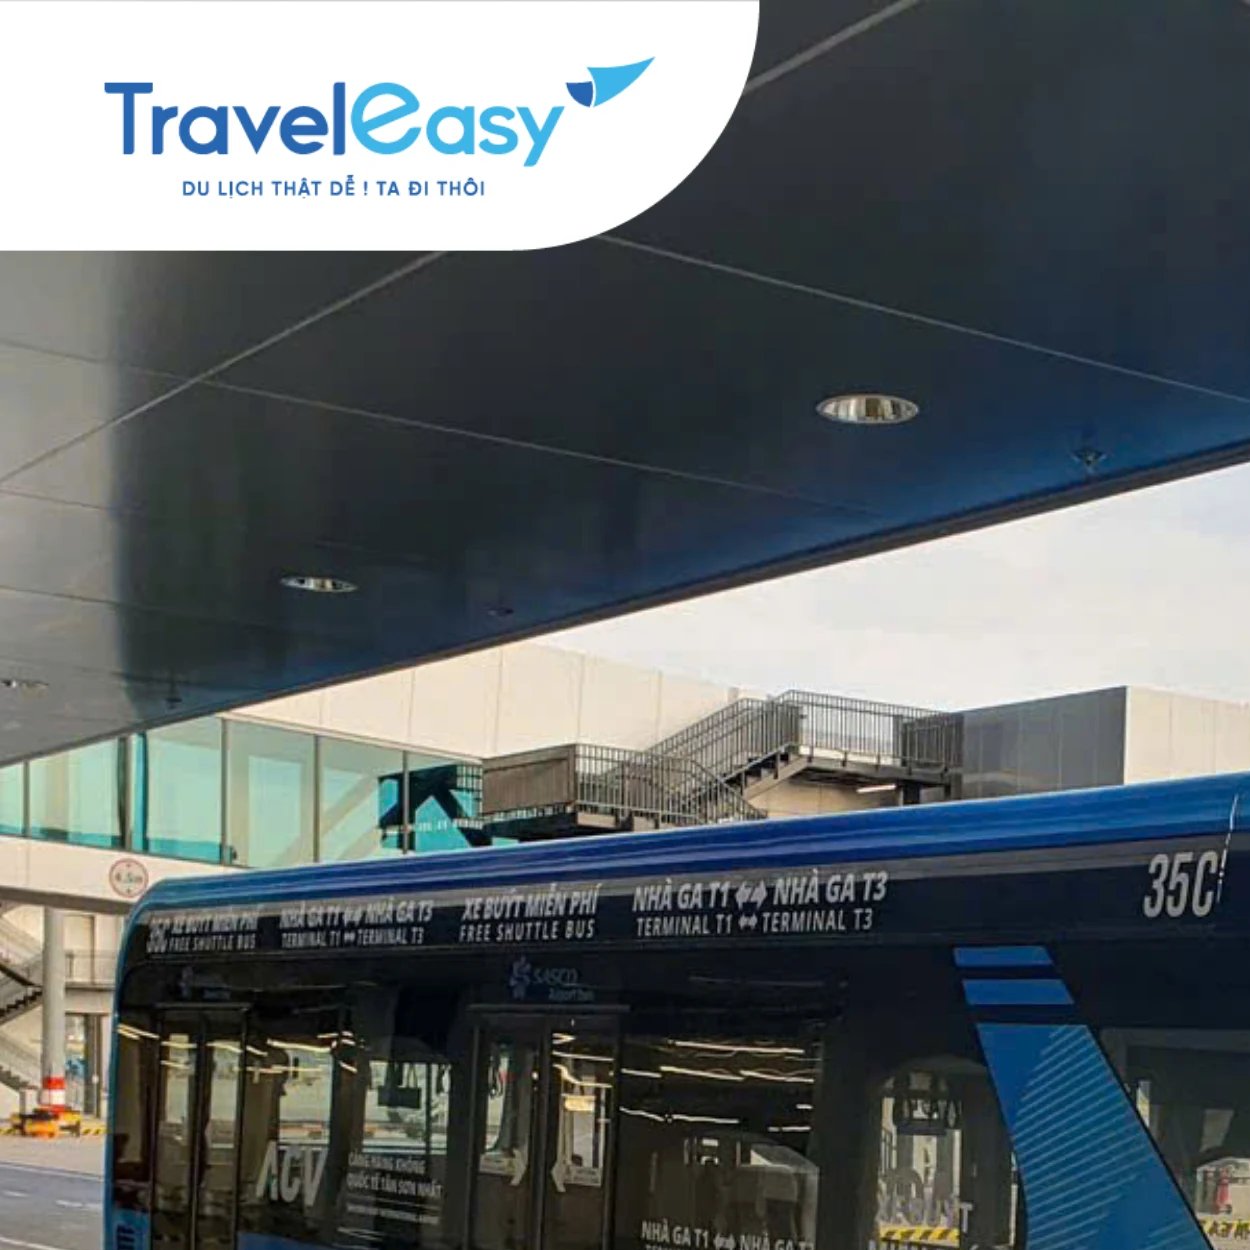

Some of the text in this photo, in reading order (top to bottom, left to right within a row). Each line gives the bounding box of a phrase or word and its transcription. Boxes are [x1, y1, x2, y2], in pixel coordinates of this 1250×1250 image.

[632, 868, 889, 912] NHÀ GA T1 NHÀ GA T3
[1143, 849, 1218, 918] 35C
[418, 899, 434, 922] T3
[462, 897, 482, 921] XE
[568, 882, 602, 916] PHÍ
[358, 926, 407, 945] TERMINAL
[411, 926, 425, 944] T3
[460, 918, 595, 942] FREE SHUTTLE BUS
[636, 908, 874, 938] TERMINAL T1 TERMINAL T3
[255, 1140, 329, 1207] ACV
[641, 1218, 671, 1243] NHÀ
[672, 1226, 692, 1247] GA
[694, 1228, 709, 1249] T1
